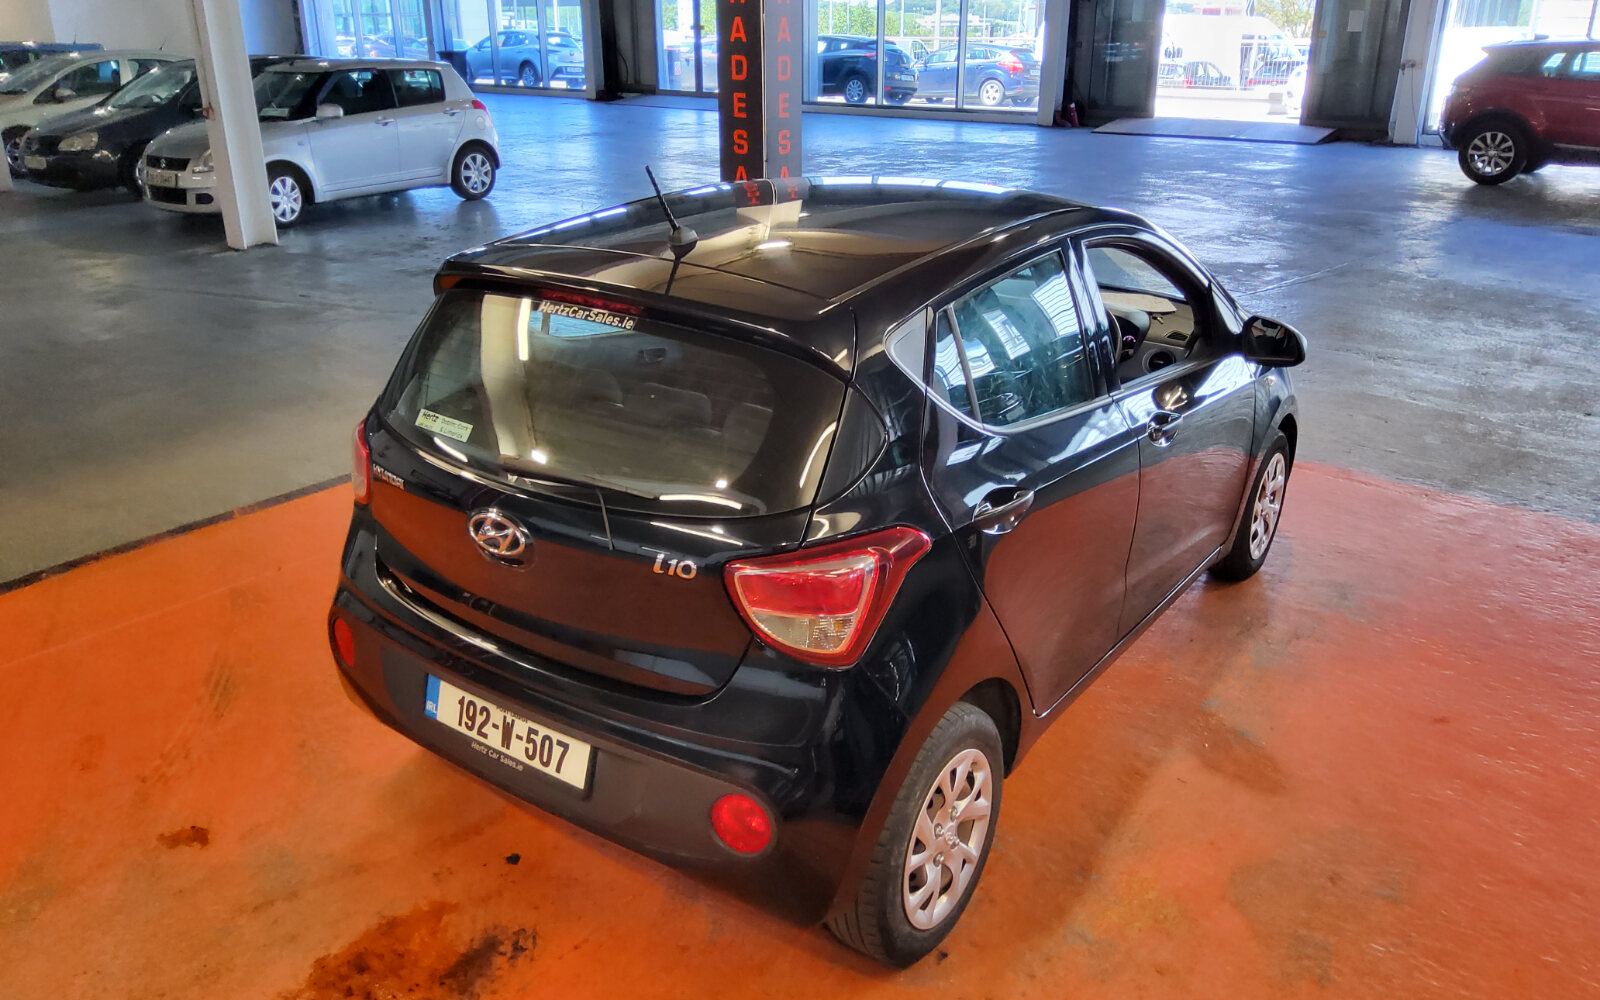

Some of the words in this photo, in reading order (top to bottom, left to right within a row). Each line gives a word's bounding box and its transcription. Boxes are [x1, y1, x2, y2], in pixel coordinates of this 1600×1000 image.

[729, 0, 749, 181] ADESA
[776, 0, 791, 179] ADESA
[537, 301, 634, 329] HertzCarSales.ie
[426, 700, 437, 713] IRL
[457, 695, 570, 774] 192-W-507
[471, 741, 488, 755] Hertz
[488, 750, 498, 761] Car
[500, 754, 524, 772] Sales.ie
